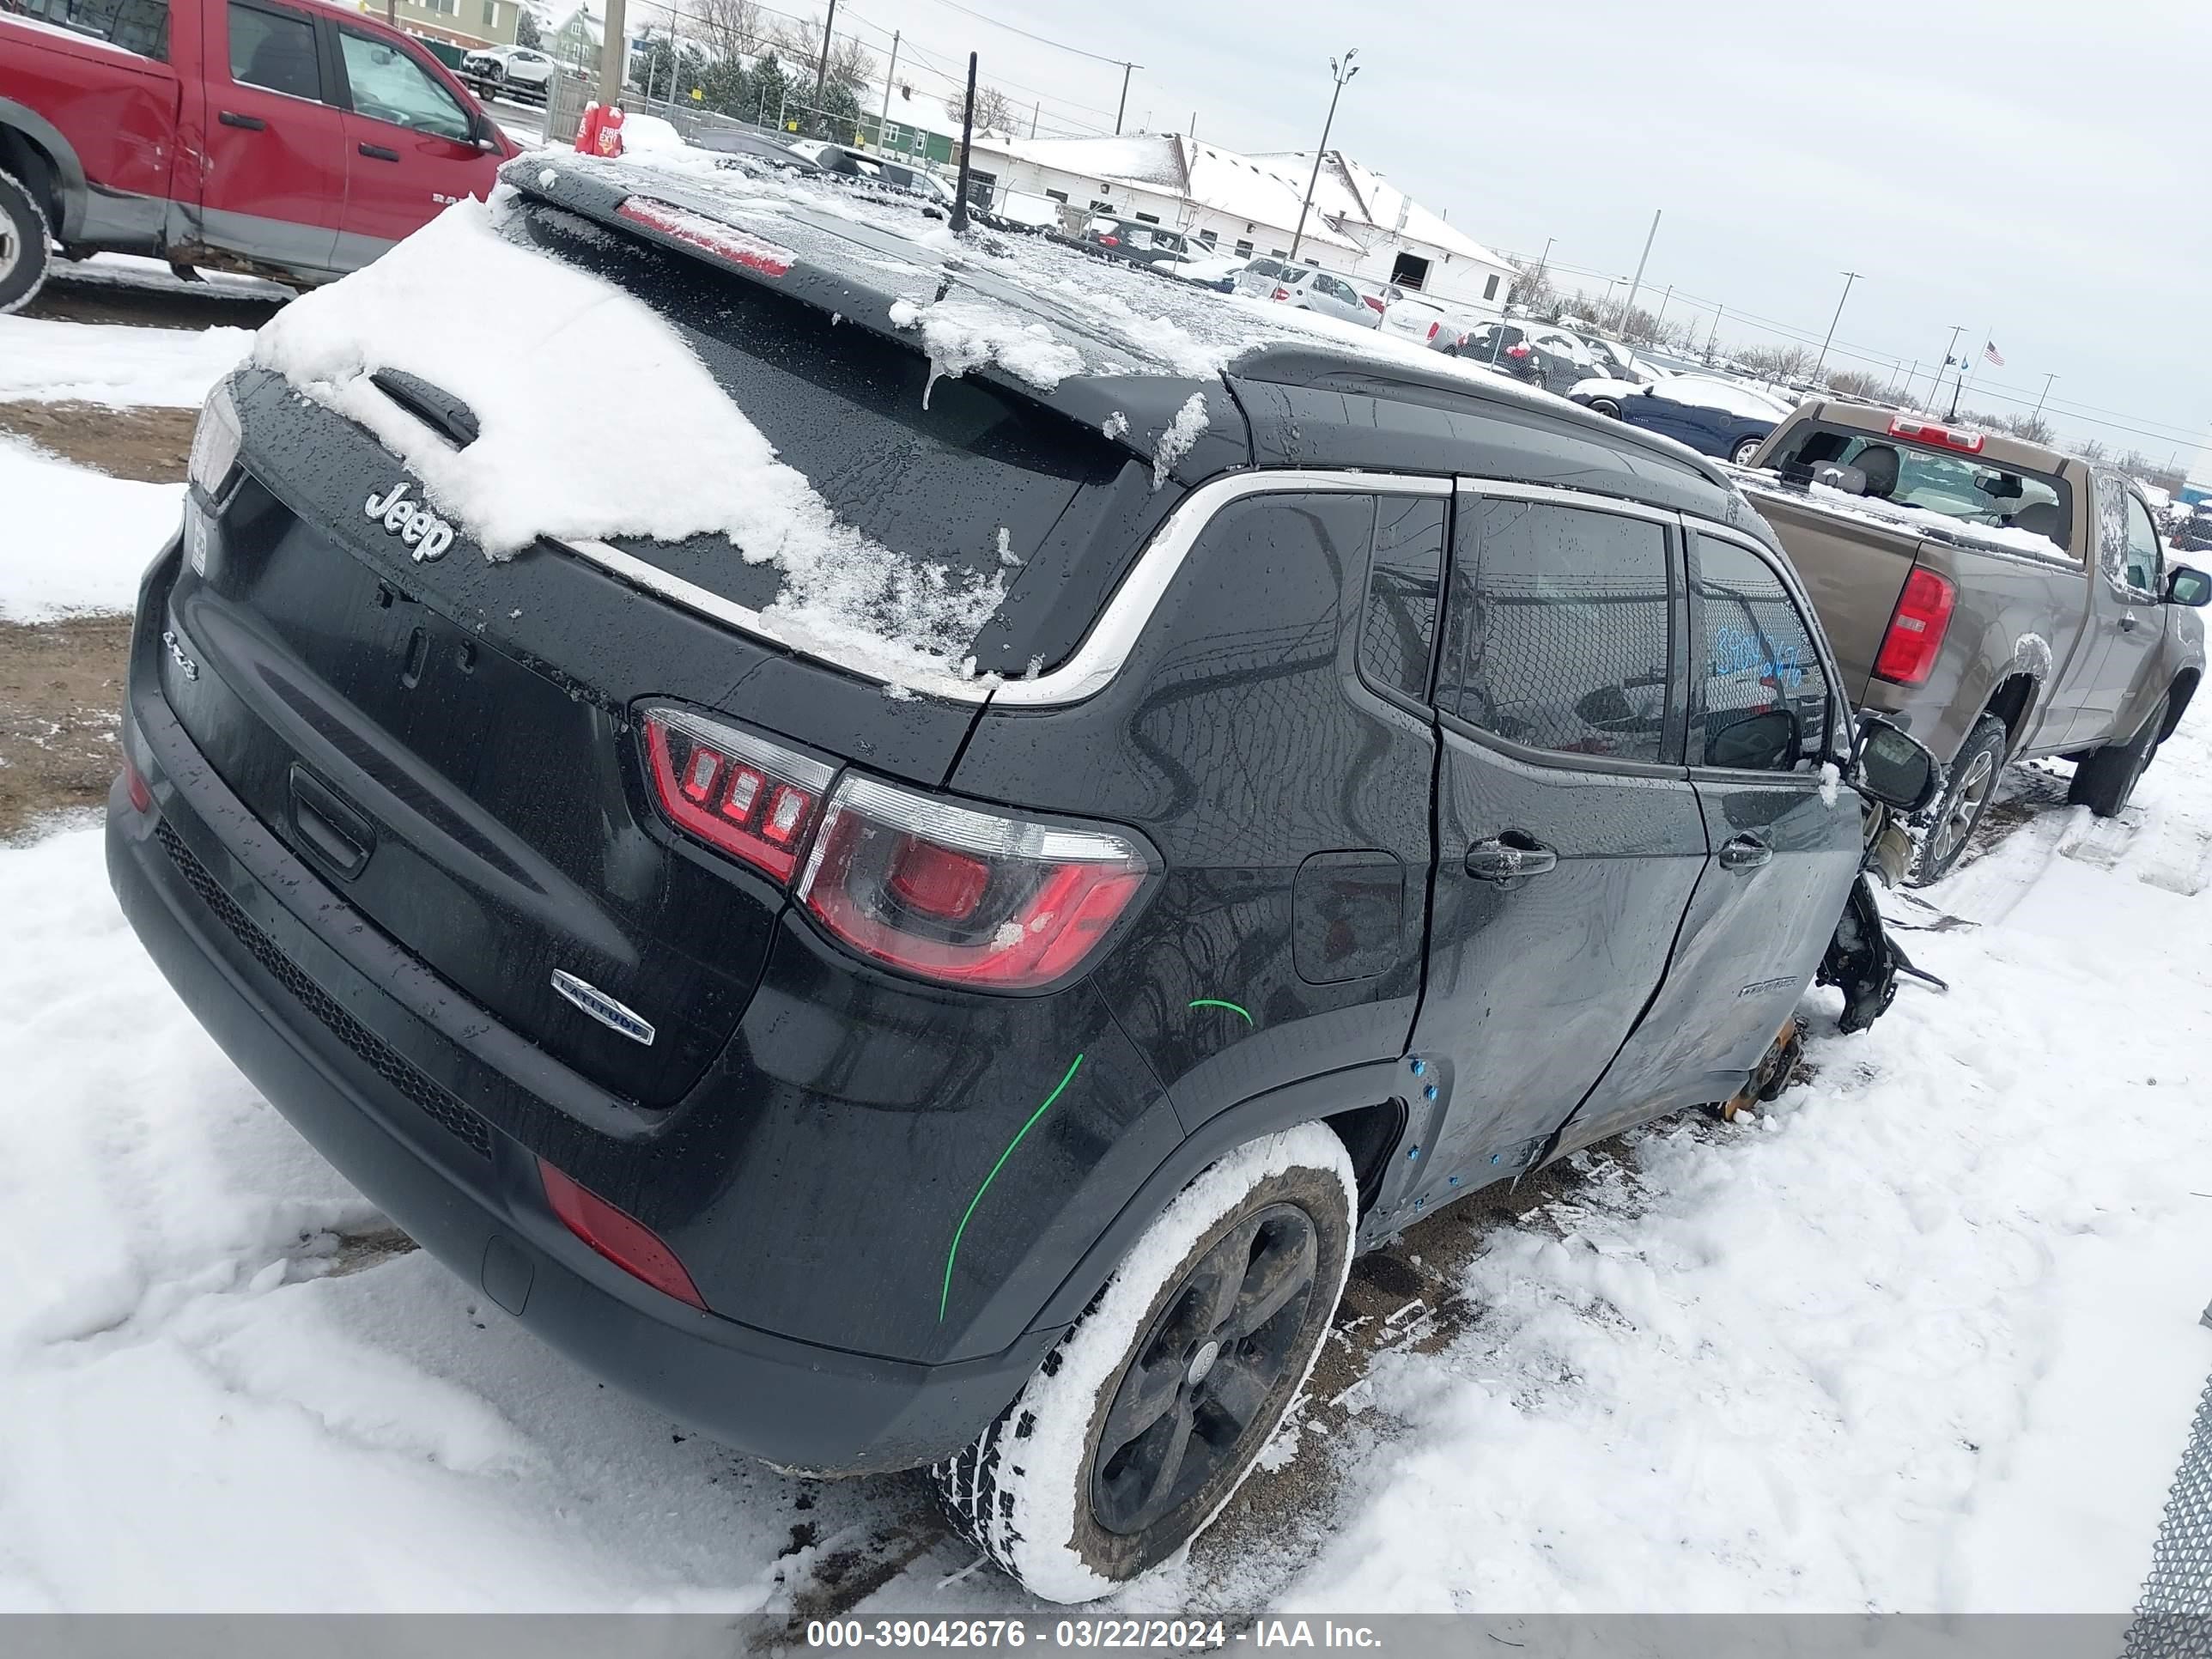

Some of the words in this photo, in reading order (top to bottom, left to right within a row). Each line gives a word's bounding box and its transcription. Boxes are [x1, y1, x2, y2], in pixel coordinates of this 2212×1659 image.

[432, 192, 464, 205] RA
[364, 481, 453, 564] Jeep
[559, 978, 642, 1036] LATITUDE
